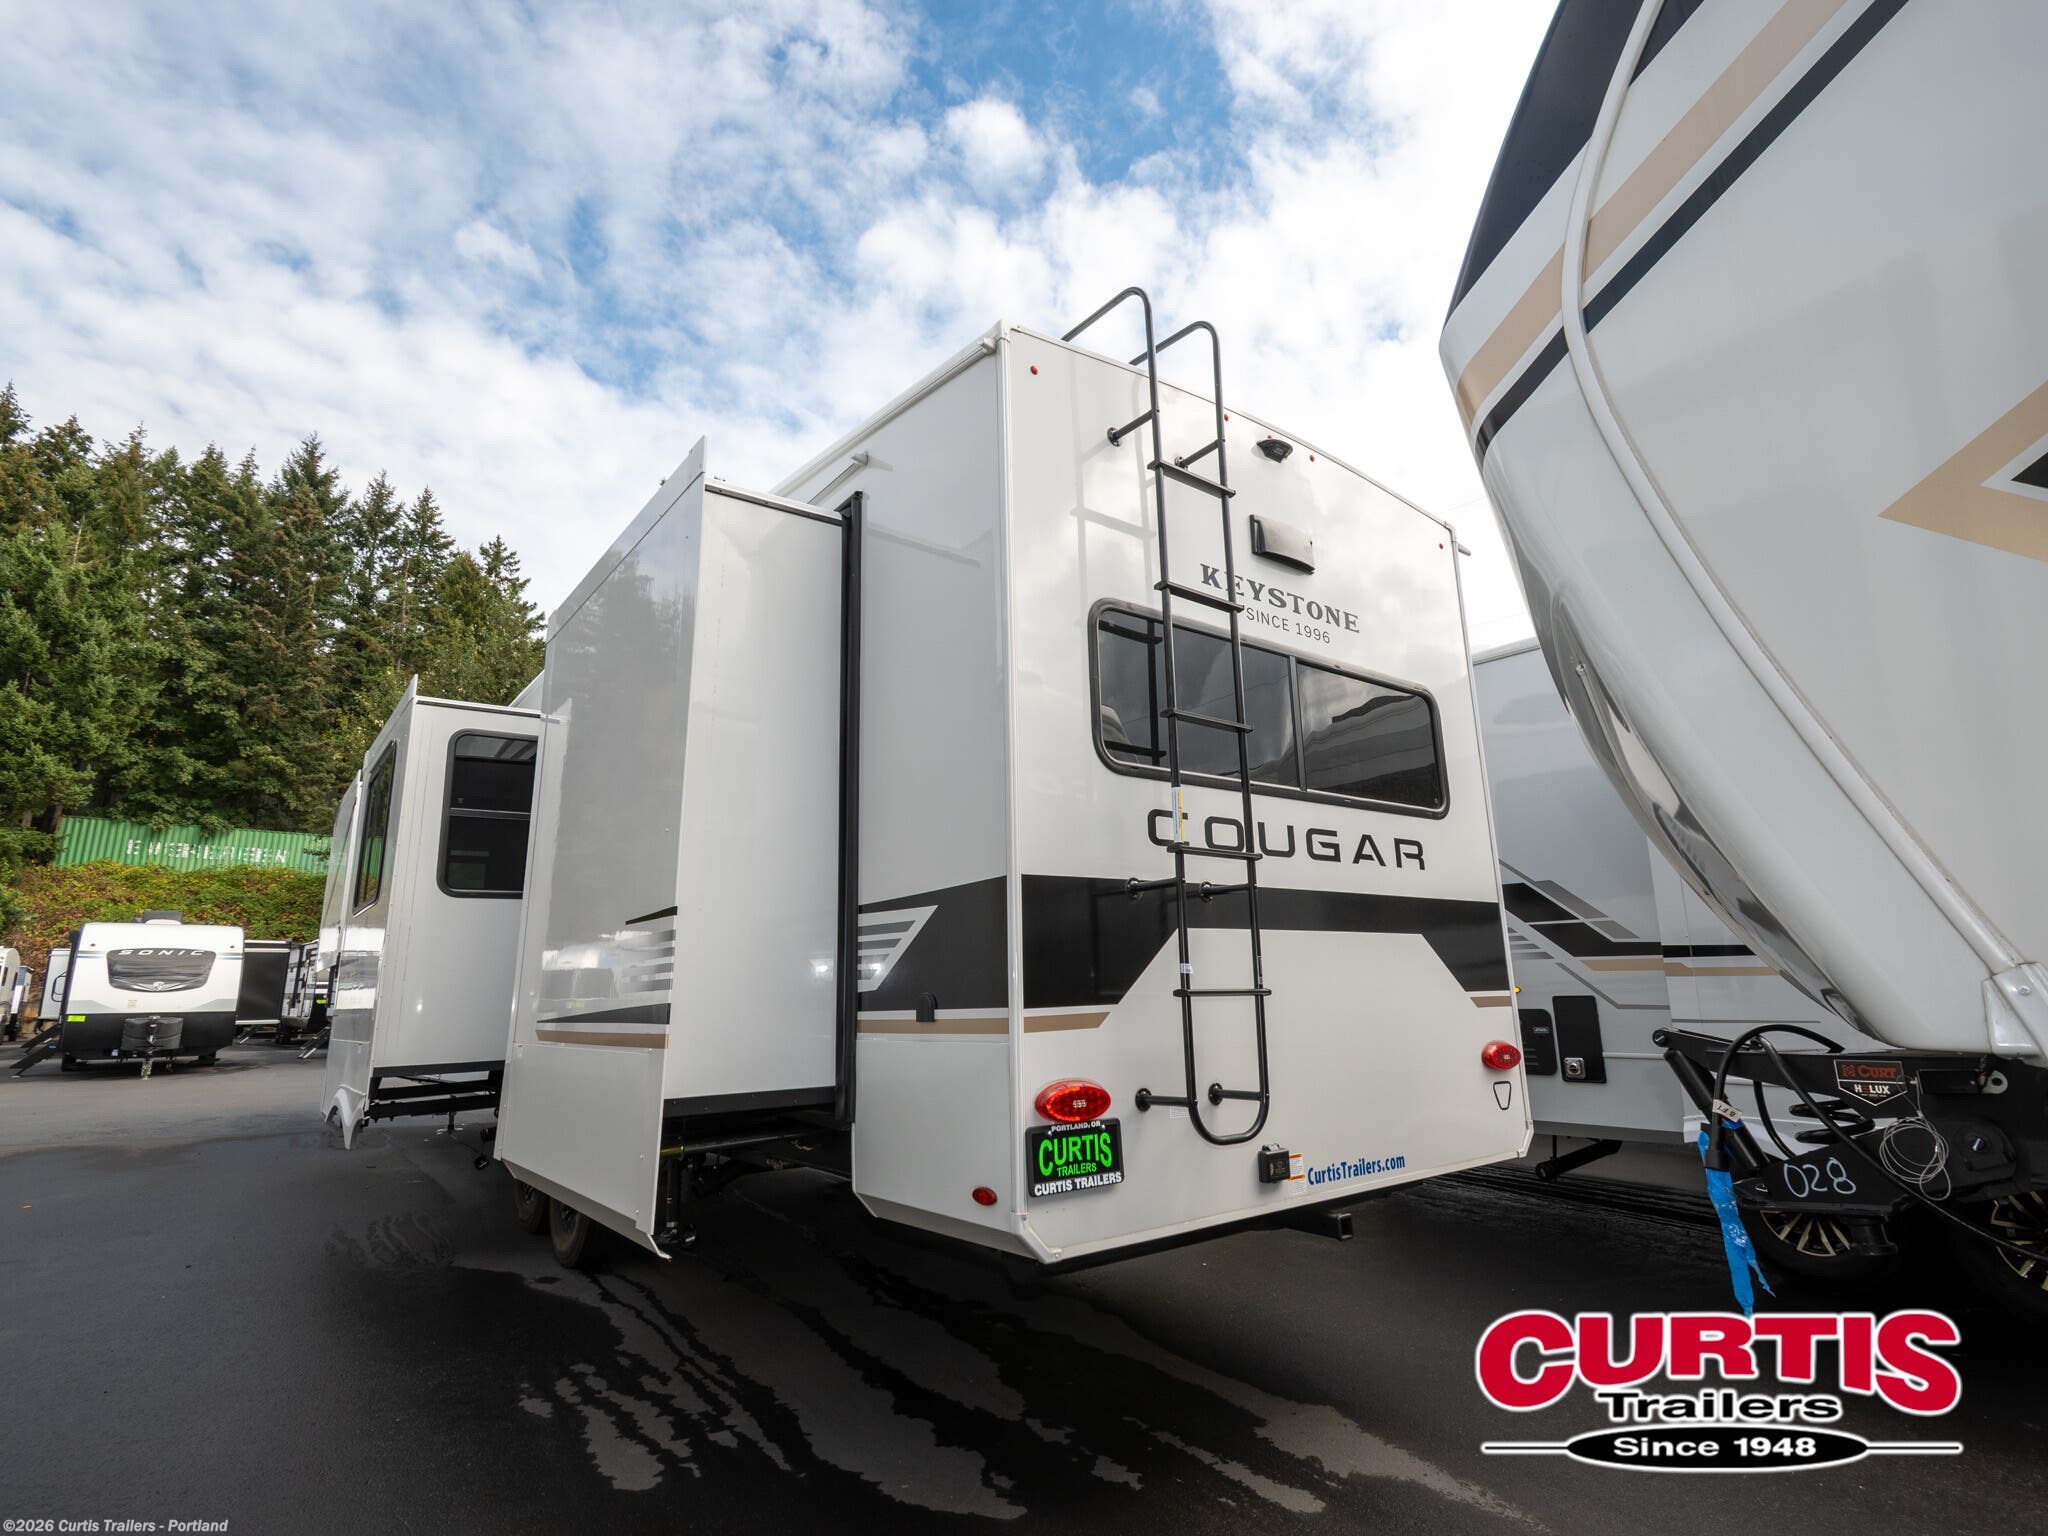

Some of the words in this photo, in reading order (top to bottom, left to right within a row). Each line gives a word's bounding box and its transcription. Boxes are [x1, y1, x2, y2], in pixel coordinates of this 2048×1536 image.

[1200, 563, 1360, 633] KEYSTONE
[1246, 607, 1290, 632] SINCE
[1296, 622, 1331, 644] 1996
[1147, 808, 1426, 871] COUGAR
[1051, 1121, 1091, 1132] PORTLAND,
[1038, 1132, 1112, 1176] CURTIS
[1056, 1162, 1097, 1177] TRAILERS
[1307, 1155, 1406, 1185] CurtisTrailers.com
[1034, 1180, 1073, 1196] CURTIS
[1074, 1172, 1122, 1189] TRAILERS
[1783, 1157, 1857, 1198] 028
